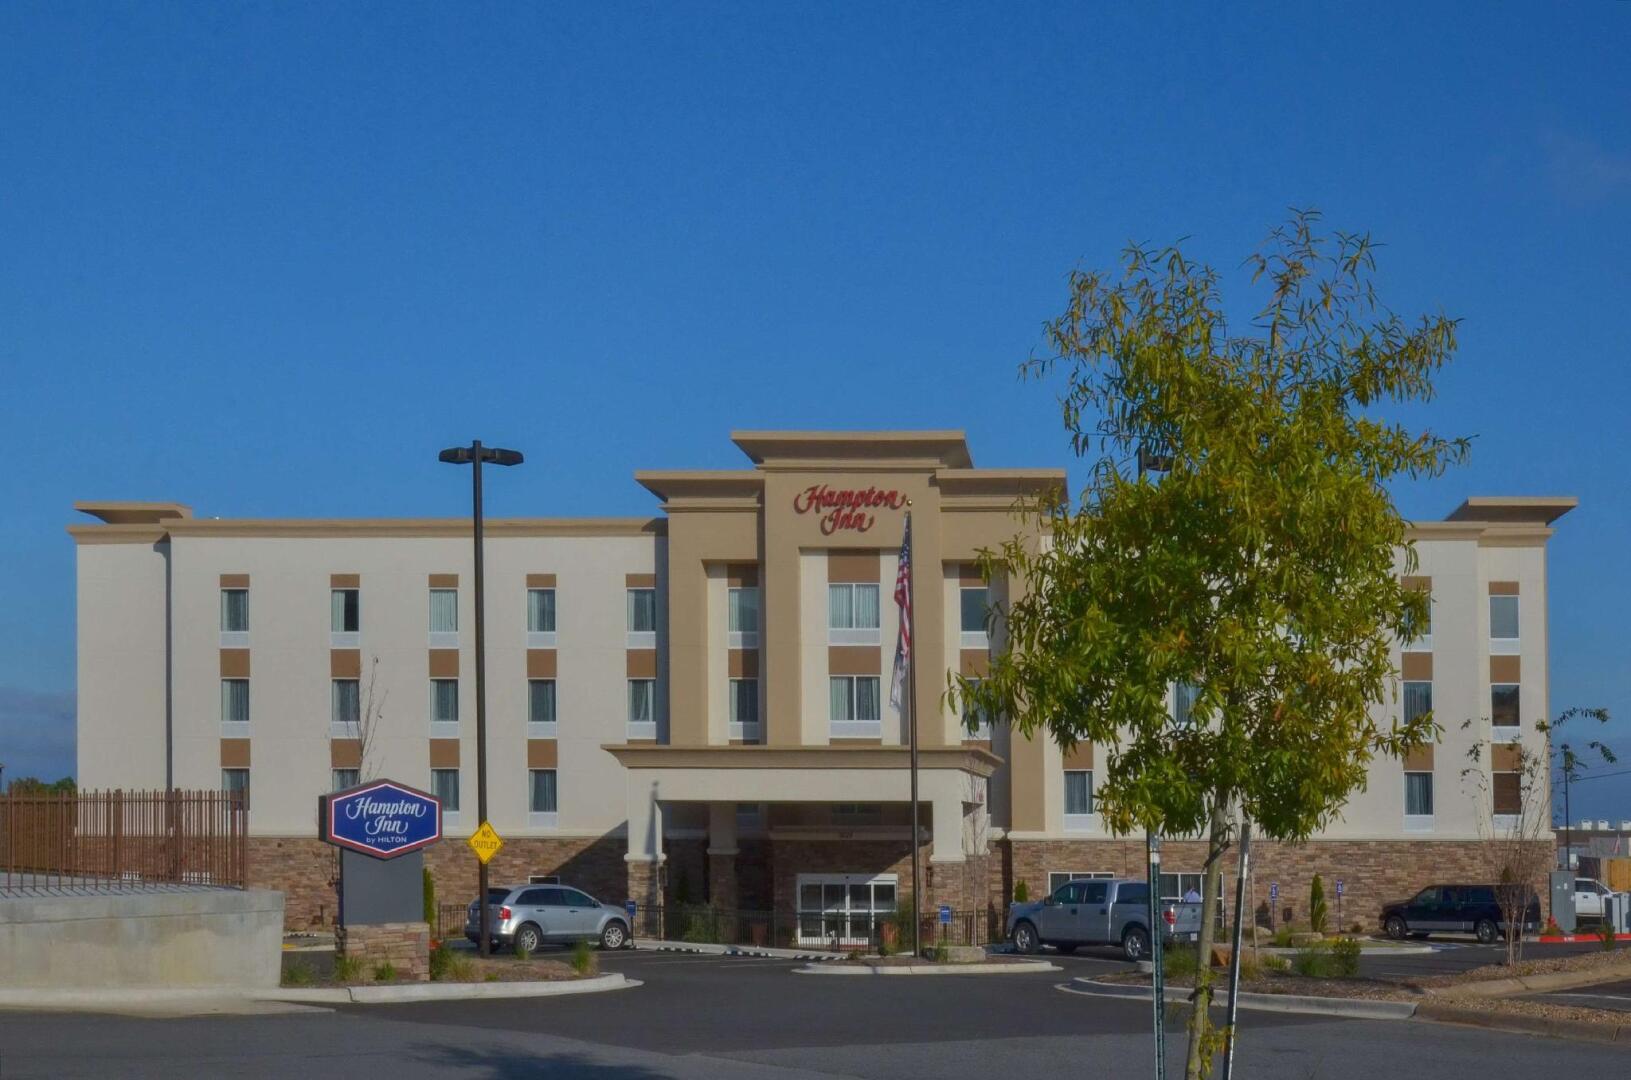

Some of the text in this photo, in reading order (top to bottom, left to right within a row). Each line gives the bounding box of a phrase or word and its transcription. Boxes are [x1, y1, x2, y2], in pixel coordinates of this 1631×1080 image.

[793, 484, 907, 514] Hampton
[820, 508, 875, 536] Inn
[345, 796, 427, 819] Hampton
[365, 815, 409, 835] Inn
[482, 830, 491, 838] NO
[366, 836, 376, 845] by
[474, 840, 498, 849] OUTLET
